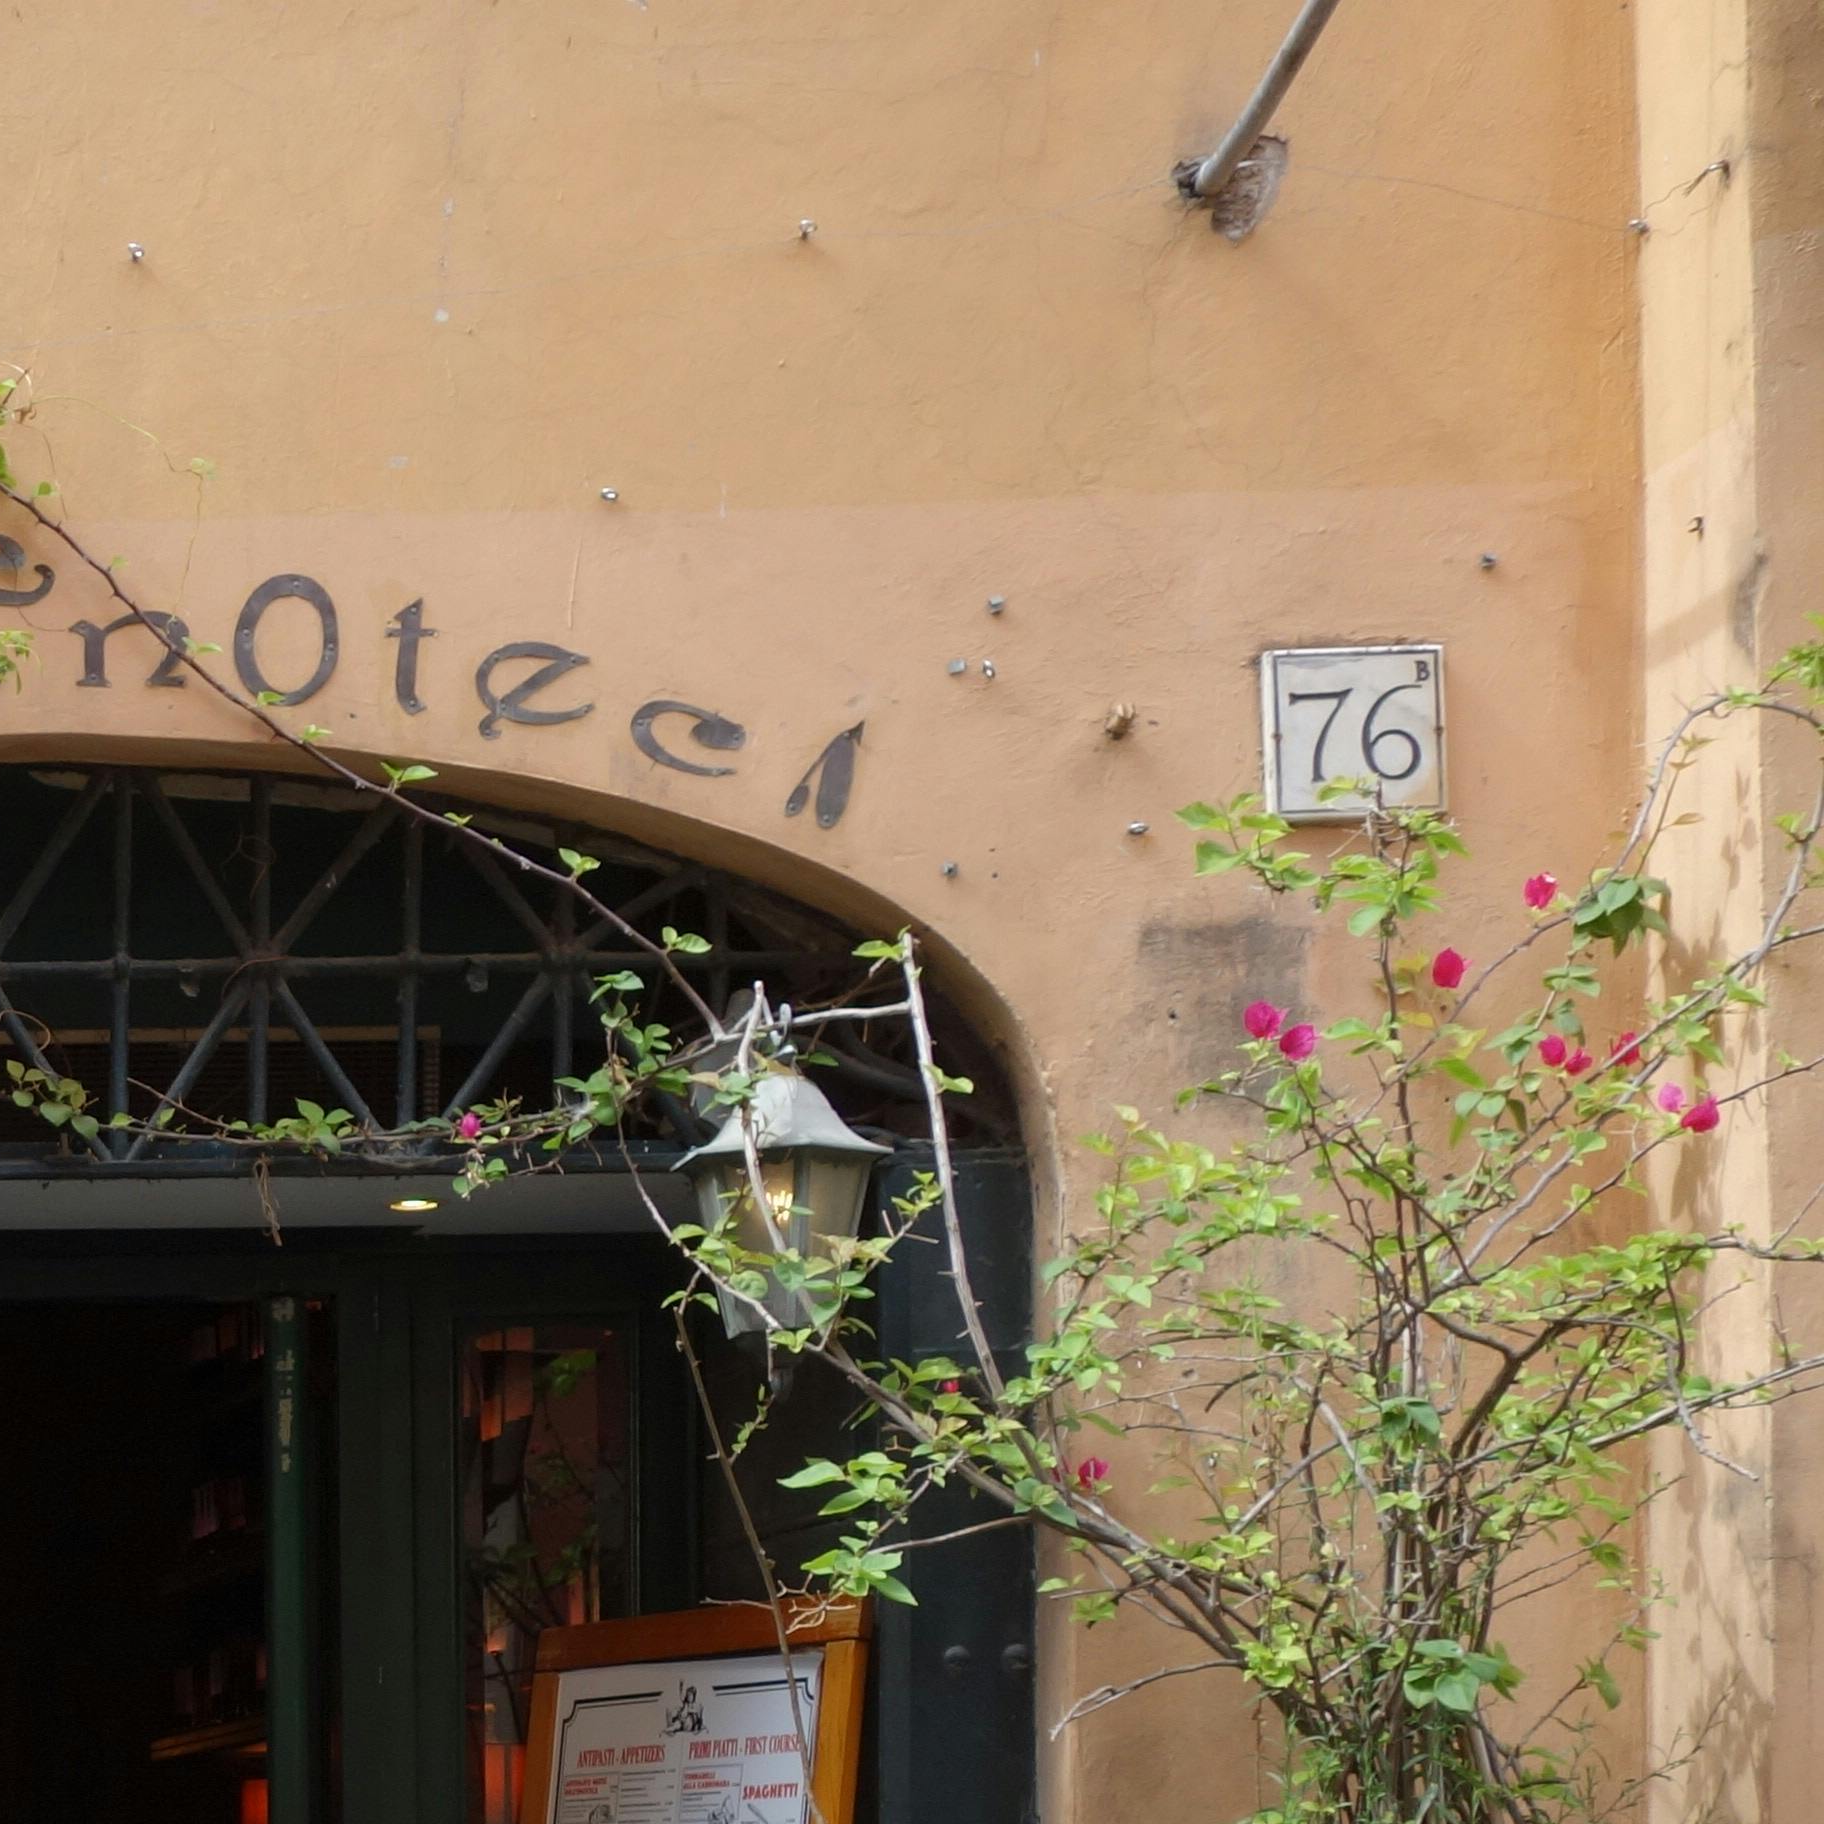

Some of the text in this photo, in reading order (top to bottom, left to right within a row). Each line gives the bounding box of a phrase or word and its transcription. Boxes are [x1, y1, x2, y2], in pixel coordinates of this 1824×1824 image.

[1414, 660, 1430, 682] B
[1288, 684, 1423, 783] 76
[743, 1783, 798, 1800] SPAGHETTI
